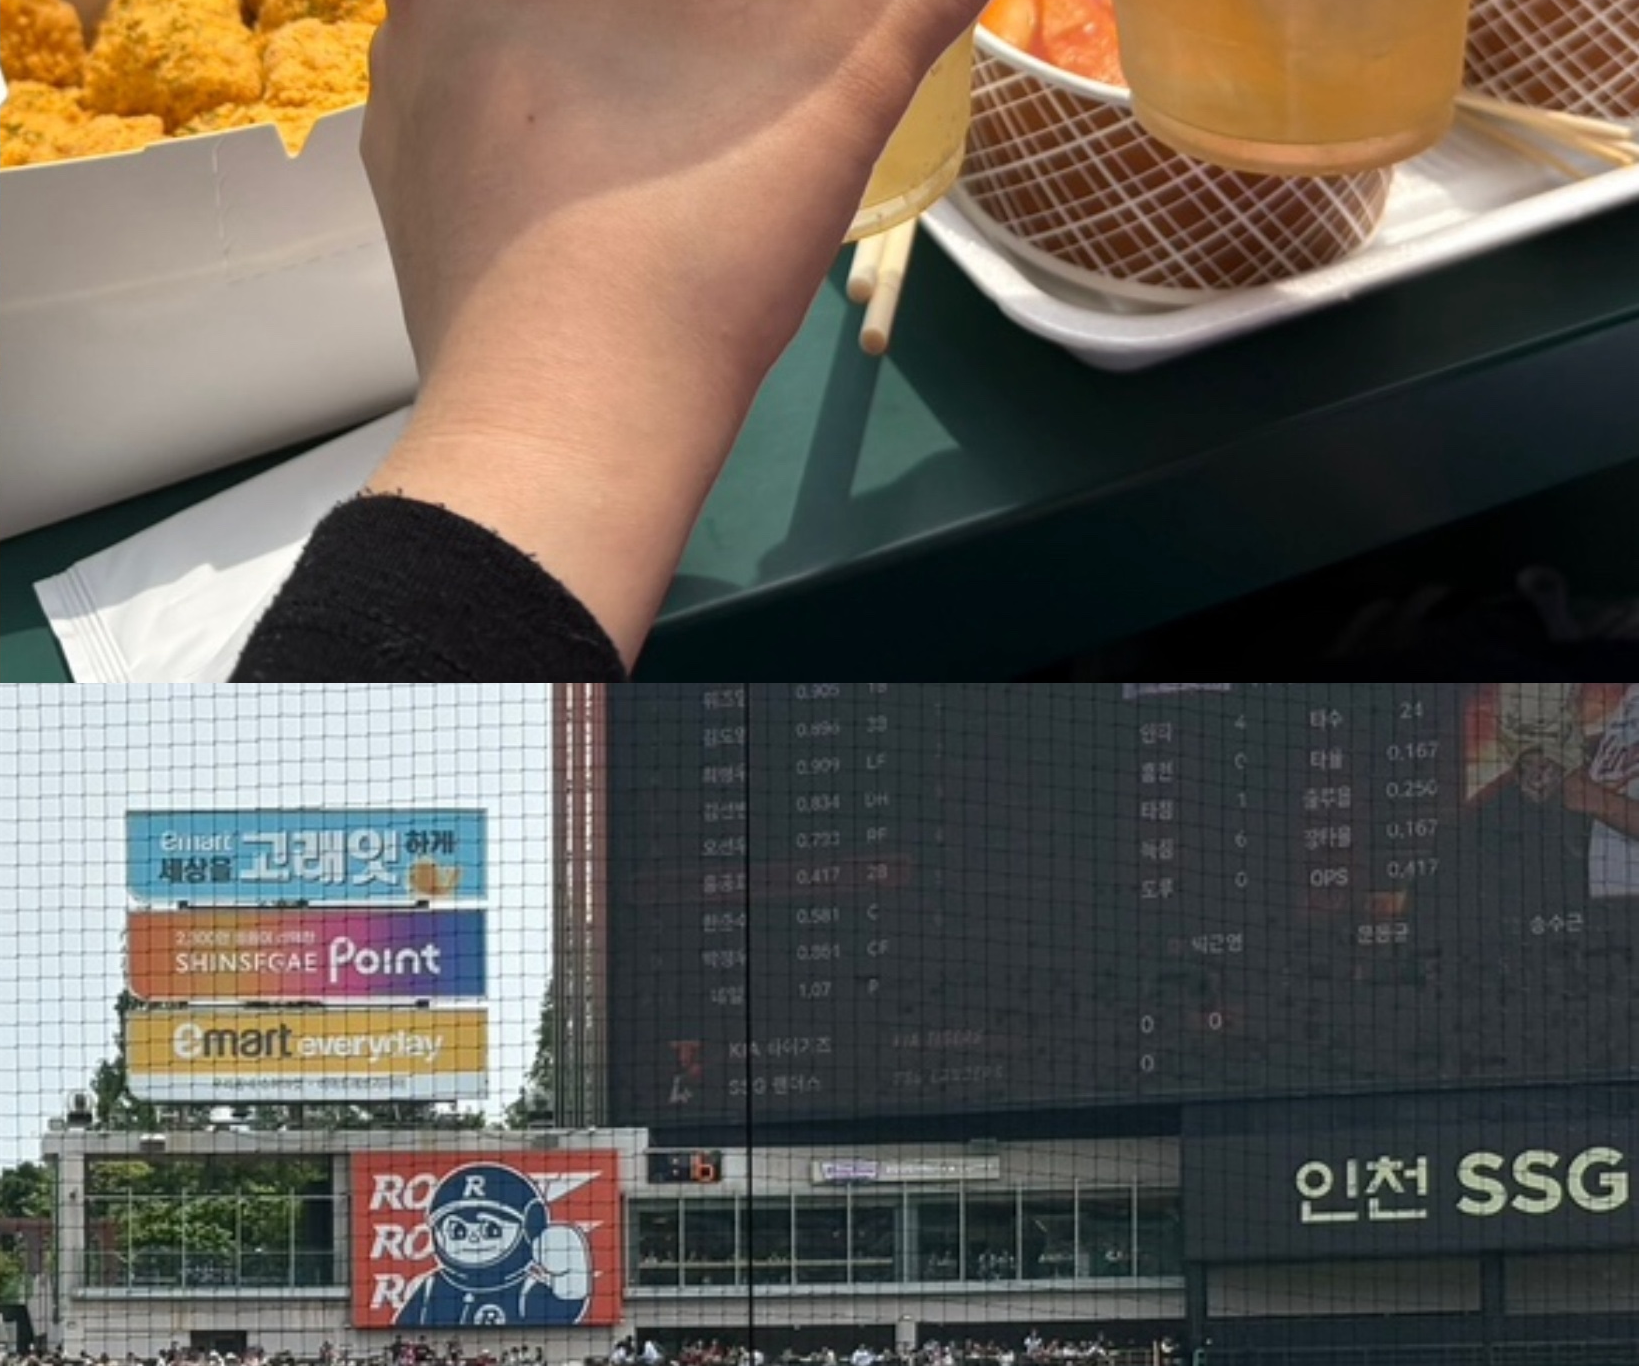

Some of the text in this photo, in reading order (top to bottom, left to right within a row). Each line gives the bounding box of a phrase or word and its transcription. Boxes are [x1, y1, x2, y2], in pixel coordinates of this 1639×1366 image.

[241, 829, 398, 884] 고래잇
[405, 830, 456, 854] 하게
[1310, 869, 1349, 887] OPS
[175, 953, 318, 974] SHINSEGAE
[330, 936, 441, 984] Point
[173, 1022, 443, 1063] emart everyday
[463, 1175, 486, 1196] R
[1296, 1146, 1629, 1222] 인천 SSG
